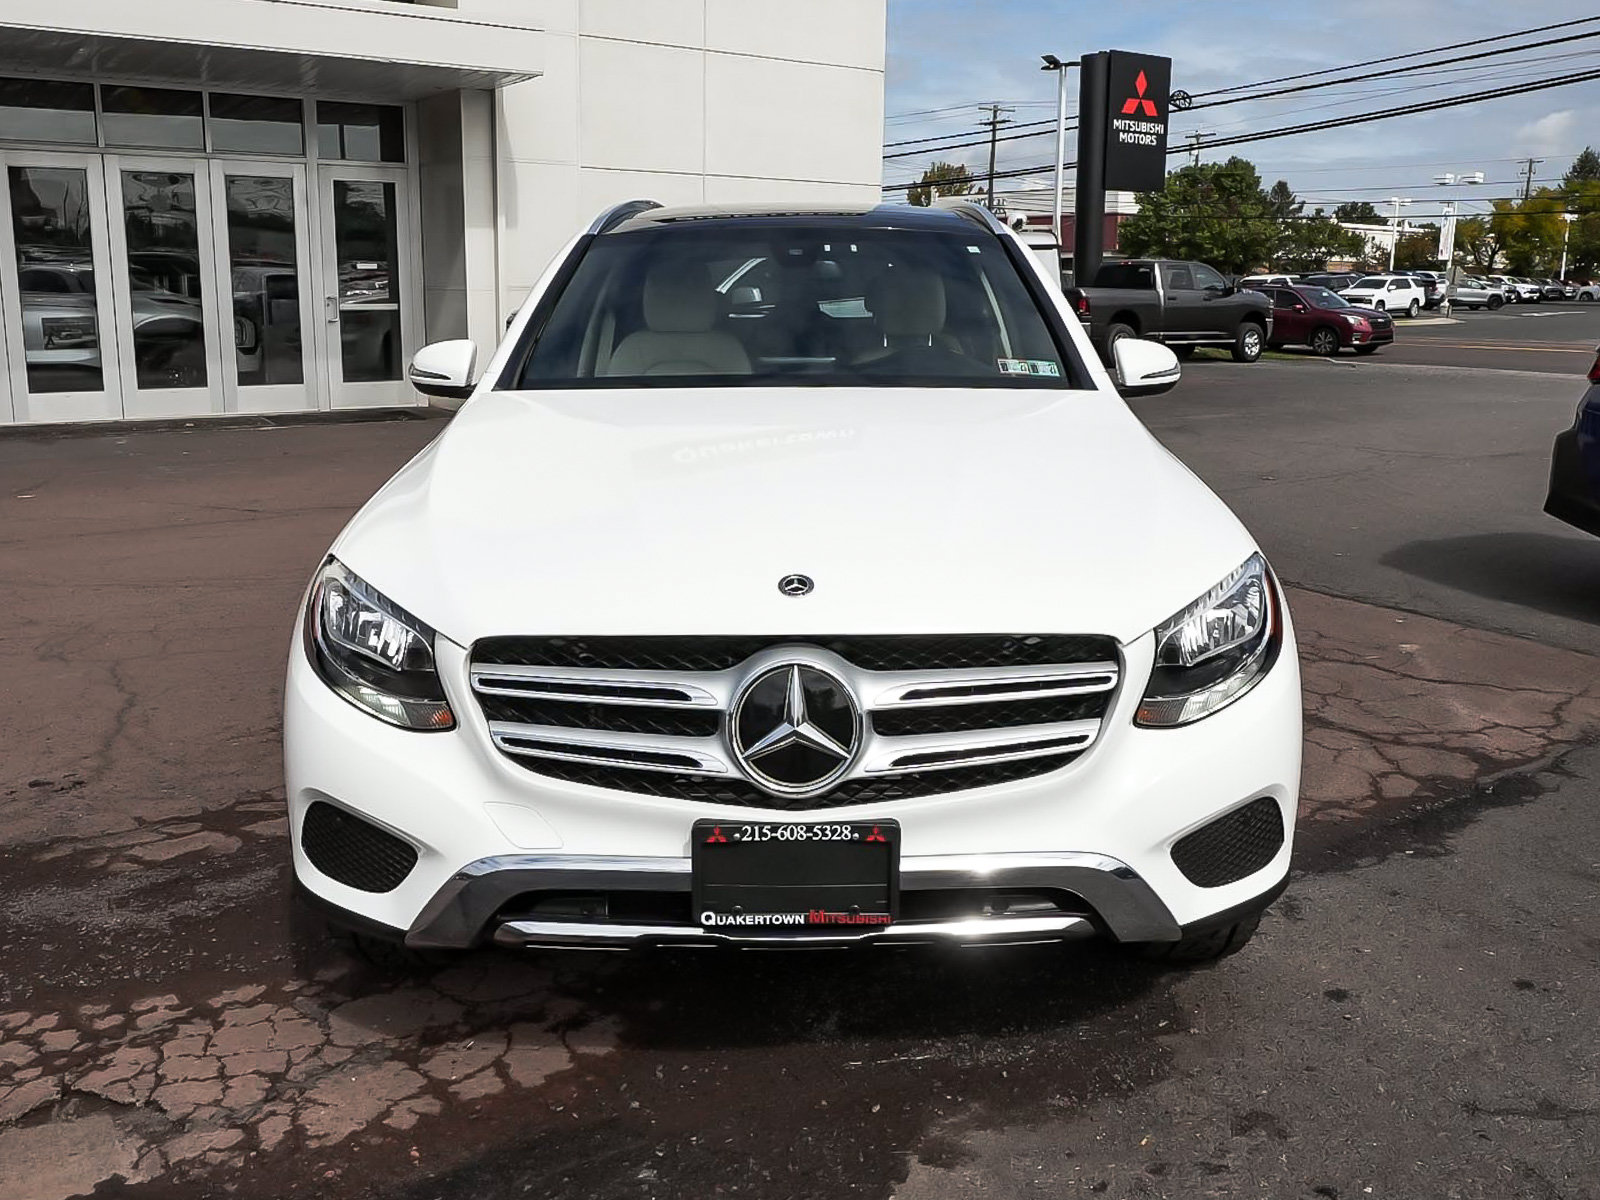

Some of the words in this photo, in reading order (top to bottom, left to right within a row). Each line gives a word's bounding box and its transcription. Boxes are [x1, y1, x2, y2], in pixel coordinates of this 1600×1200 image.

[1113, 119, 1164, 134] MITSUBISHI
[1119, 132, 1157, 145] MOTORS
[741, 825, 852, 841] 215-608-5328
[700, 911, 805, 926] QUAKERTOWN
[809, 909, 892, 924] MITSUBISHI
